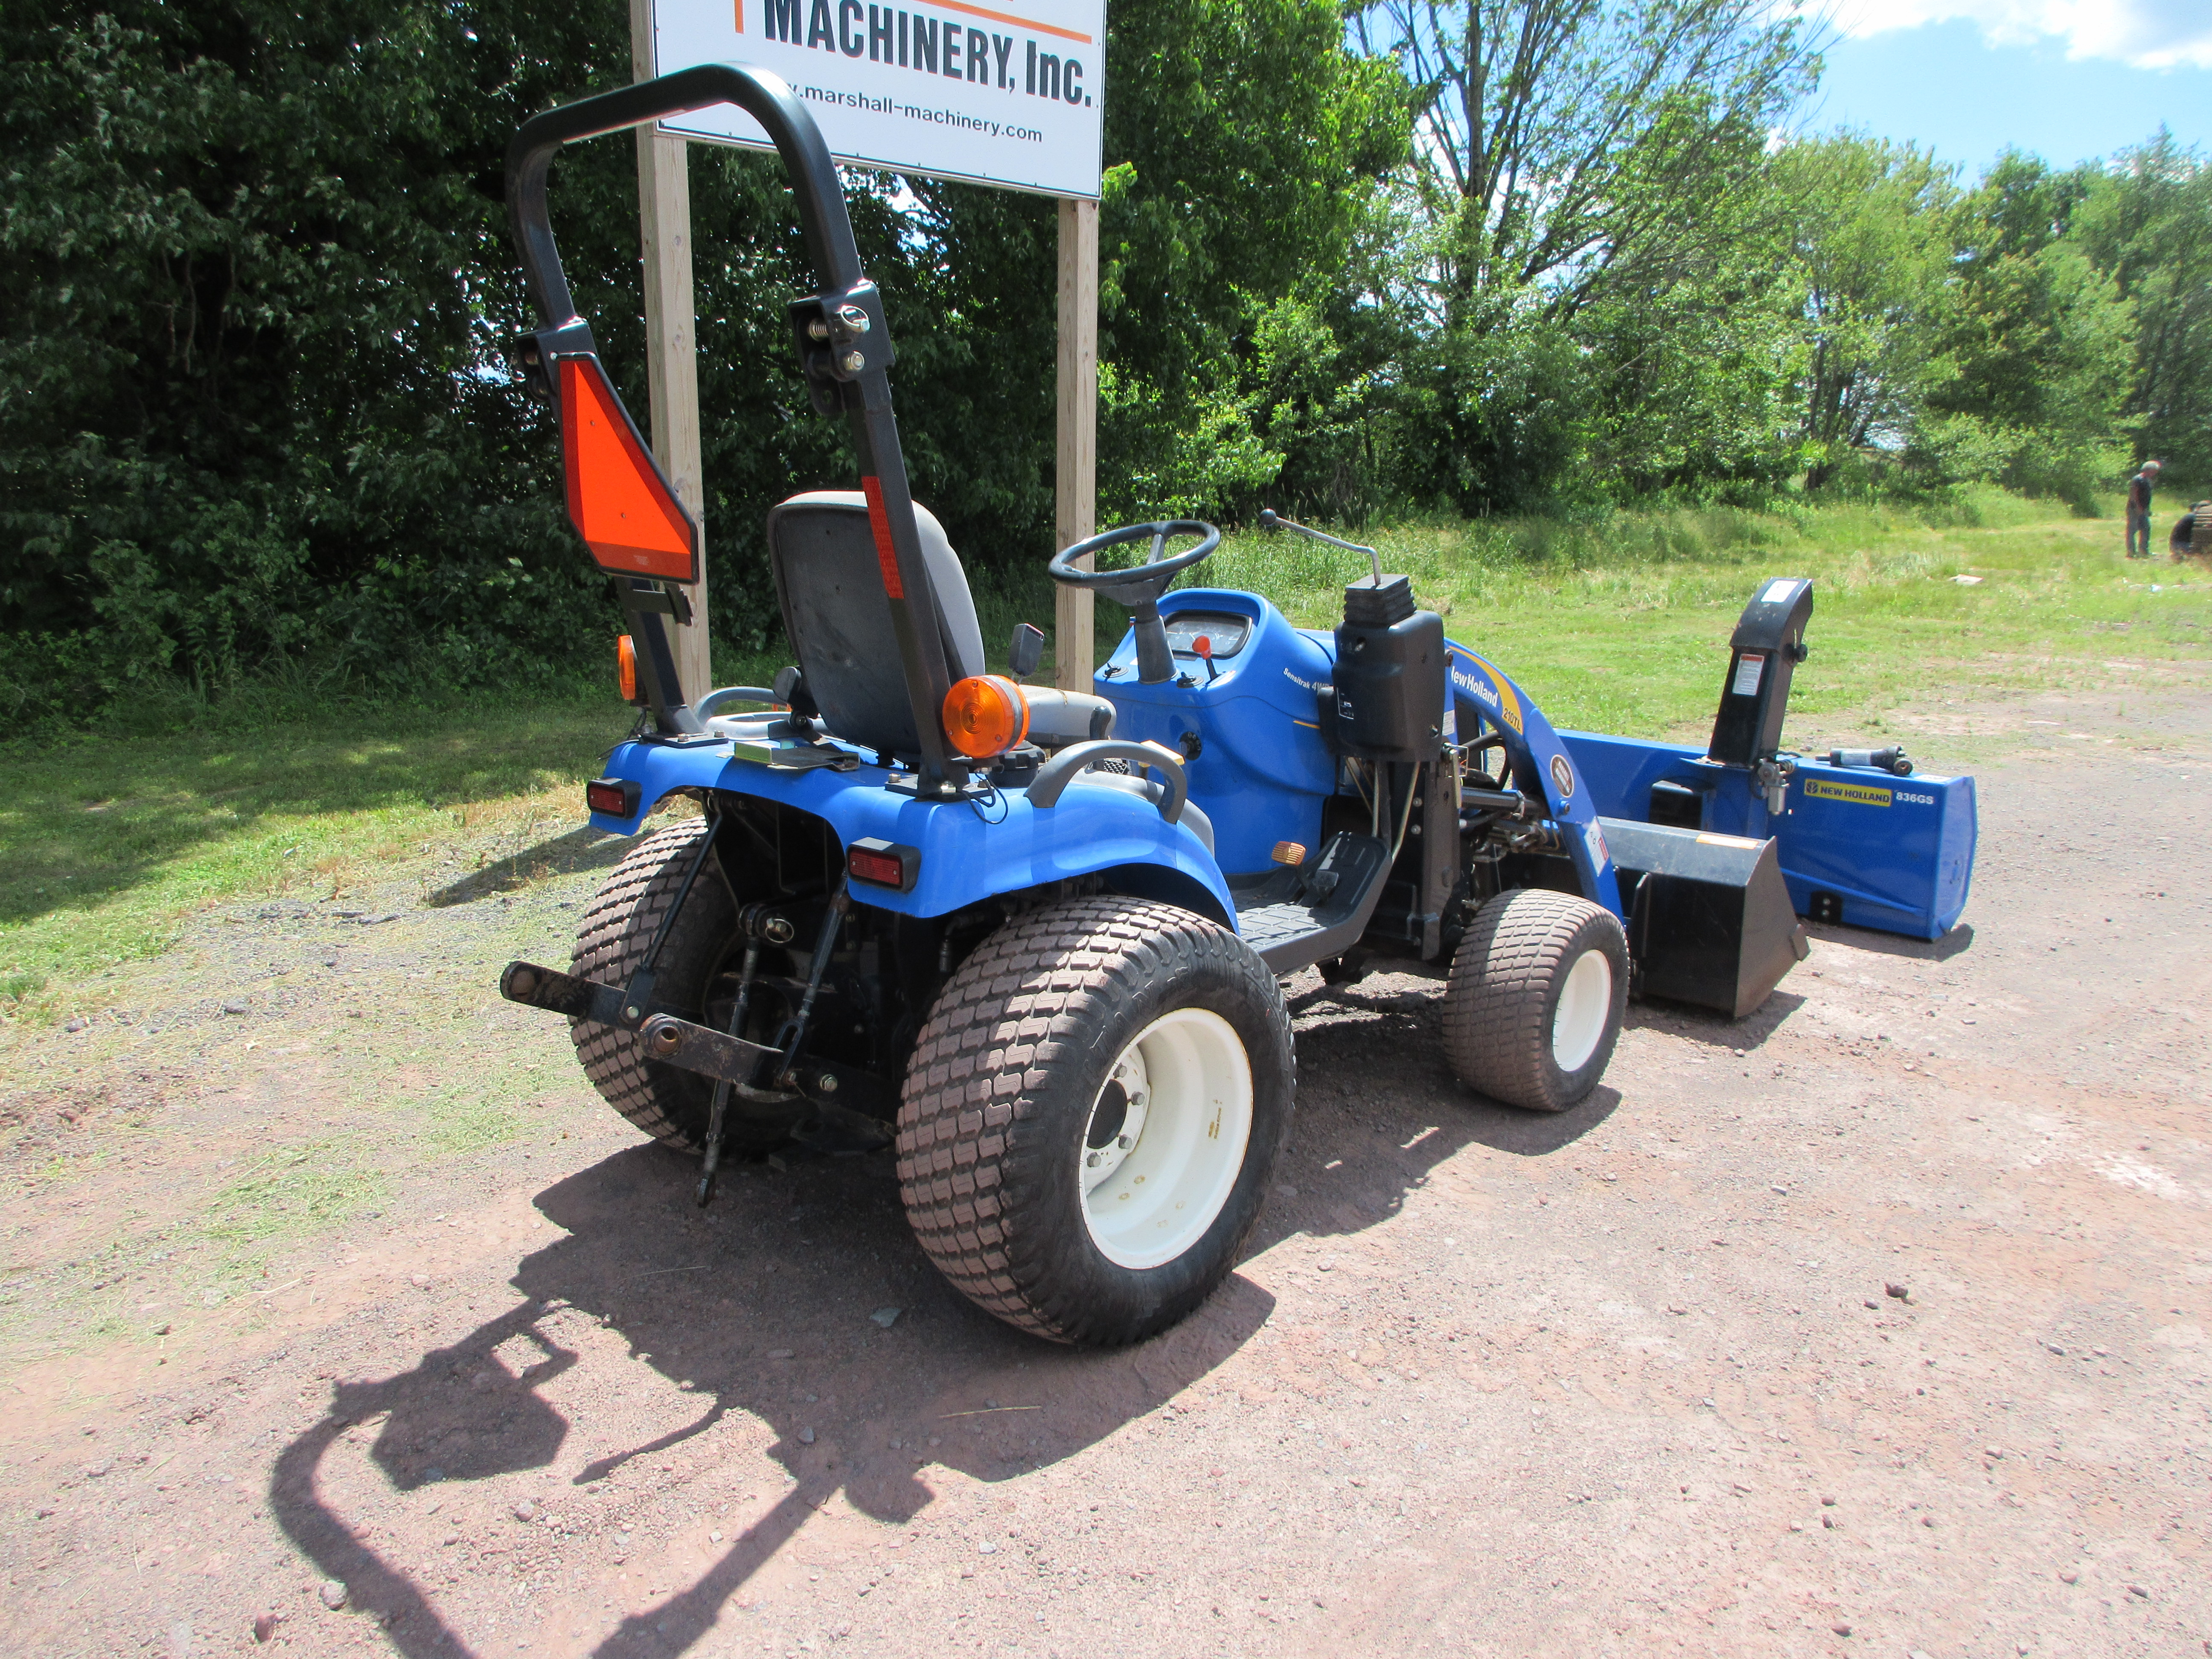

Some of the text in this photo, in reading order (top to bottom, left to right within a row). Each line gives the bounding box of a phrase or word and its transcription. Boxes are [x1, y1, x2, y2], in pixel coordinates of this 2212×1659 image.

[764, 0, 1091, 108] MACHINERY, Inc.
[1284, 667, 1310, 689] Sensitrak
[1467, 673, 1498, 707] Holland
[1503, 707, 1520, 731] 210TL
[1820, 786, 1890, 803] NEW HOLLAND
[1896, 791, 1934, 805] 836GS
